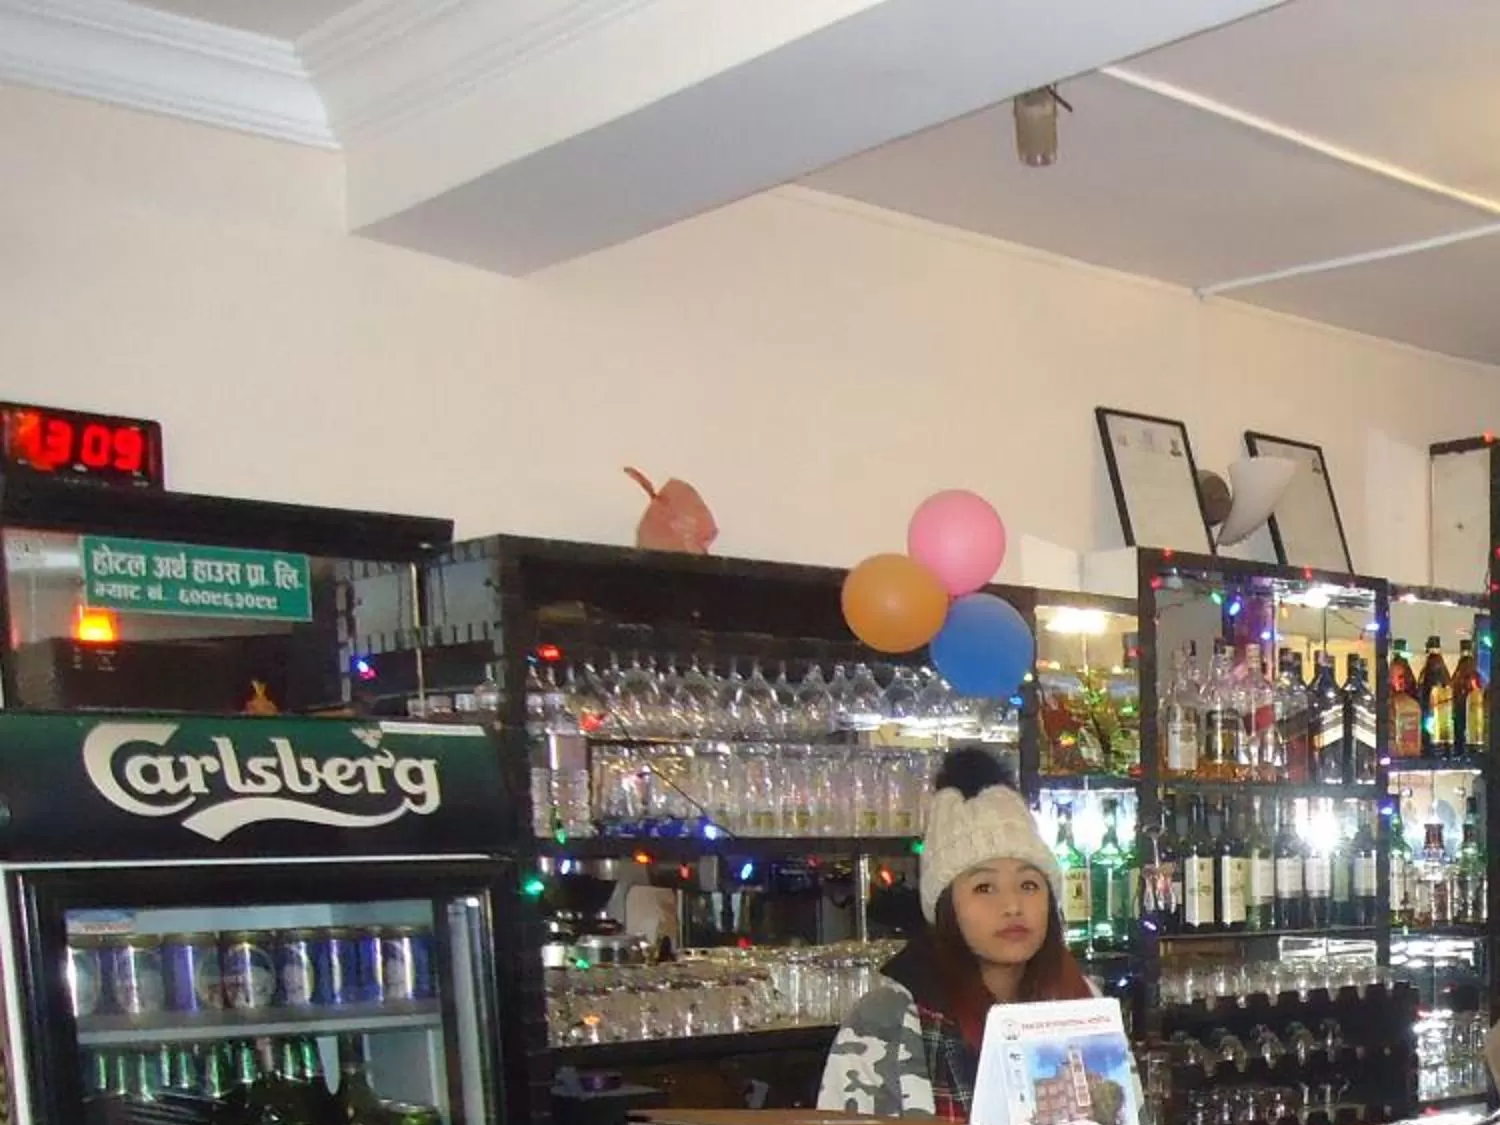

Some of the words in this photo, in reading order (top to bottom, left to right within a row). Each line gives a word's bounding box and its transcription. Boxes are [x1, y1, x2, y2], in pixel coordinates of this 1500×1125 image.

[92, 543, 147, 577] होटल
[191, 558, 240, 585] हाउस
[83, 722, 441, 818] Carlsberg
